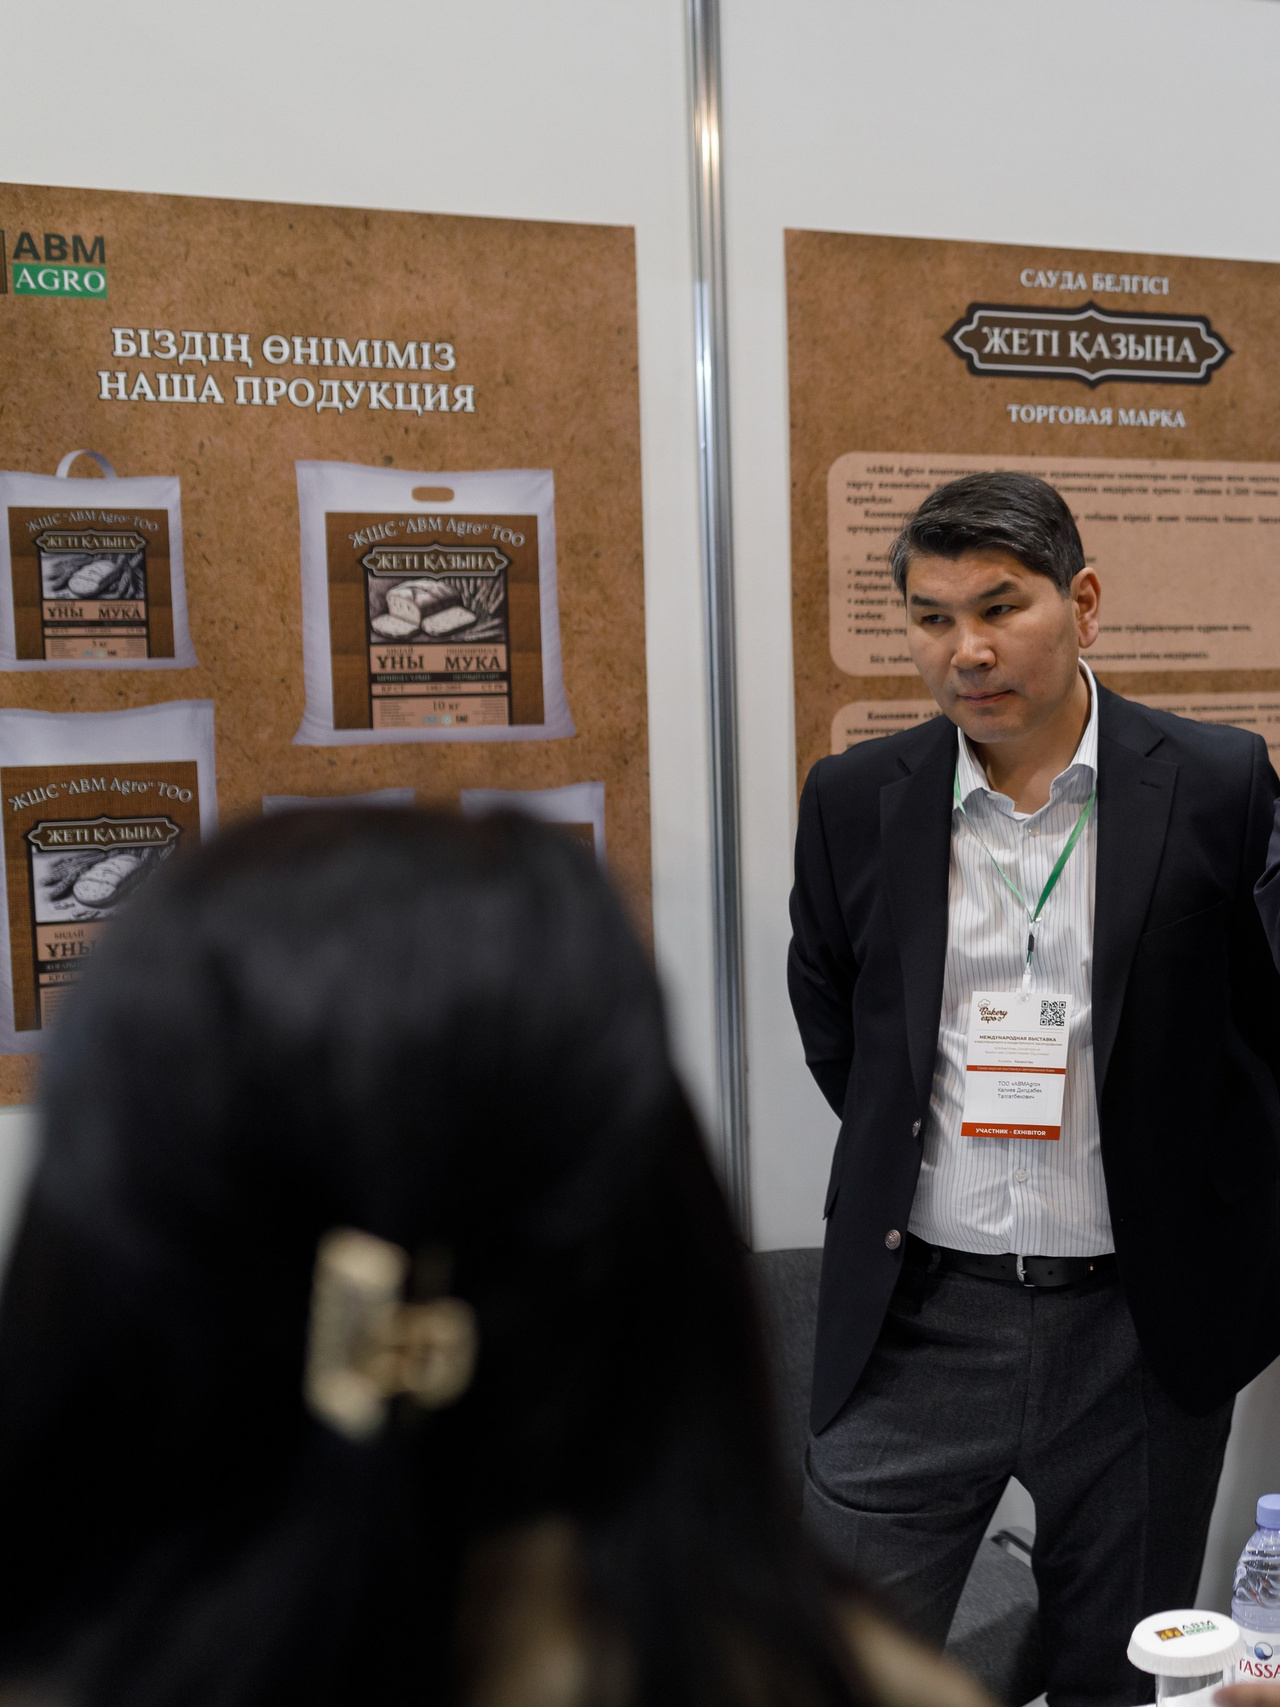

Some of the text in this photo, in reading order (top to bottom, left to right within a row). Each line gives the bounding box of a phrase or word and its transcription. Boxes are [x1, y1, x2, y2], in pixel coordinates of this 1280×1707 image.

[13, 231, 106, 264] ABM
[15, 266, 106, 293] AGRO
[1020, 268, 1170, 295] САУДА БЕЛГІСІ
[111, 327, 456, 372] БІЗДІҢ ӨНІМІМІЗ
[981, 325, 1198, 363] ЖЕТІ ҚАЗЫНА
[97, 370, 476, 416] НАША ПРОДУКЦИЯ
[1006, 404, 1187, 428] ТОРГОВАЯ МАРКА
[348, 520, 398, 549] ЖШС
[491, 525, 526, 547] ТОО
[375, 553, 419, 570] ЖЕТІ
[98, 607, 143, 619] МУКА
[377, 655, 501, 672] ҰНЫ МУКА
[8, 784, 59, 812] ЖШС
[157, 782, 193, 803] ТОО
[47, 825, 163, 844] ЖЕТІ ҚАЗЫНА
[979, 1006, 1008, 1019] Bakery
